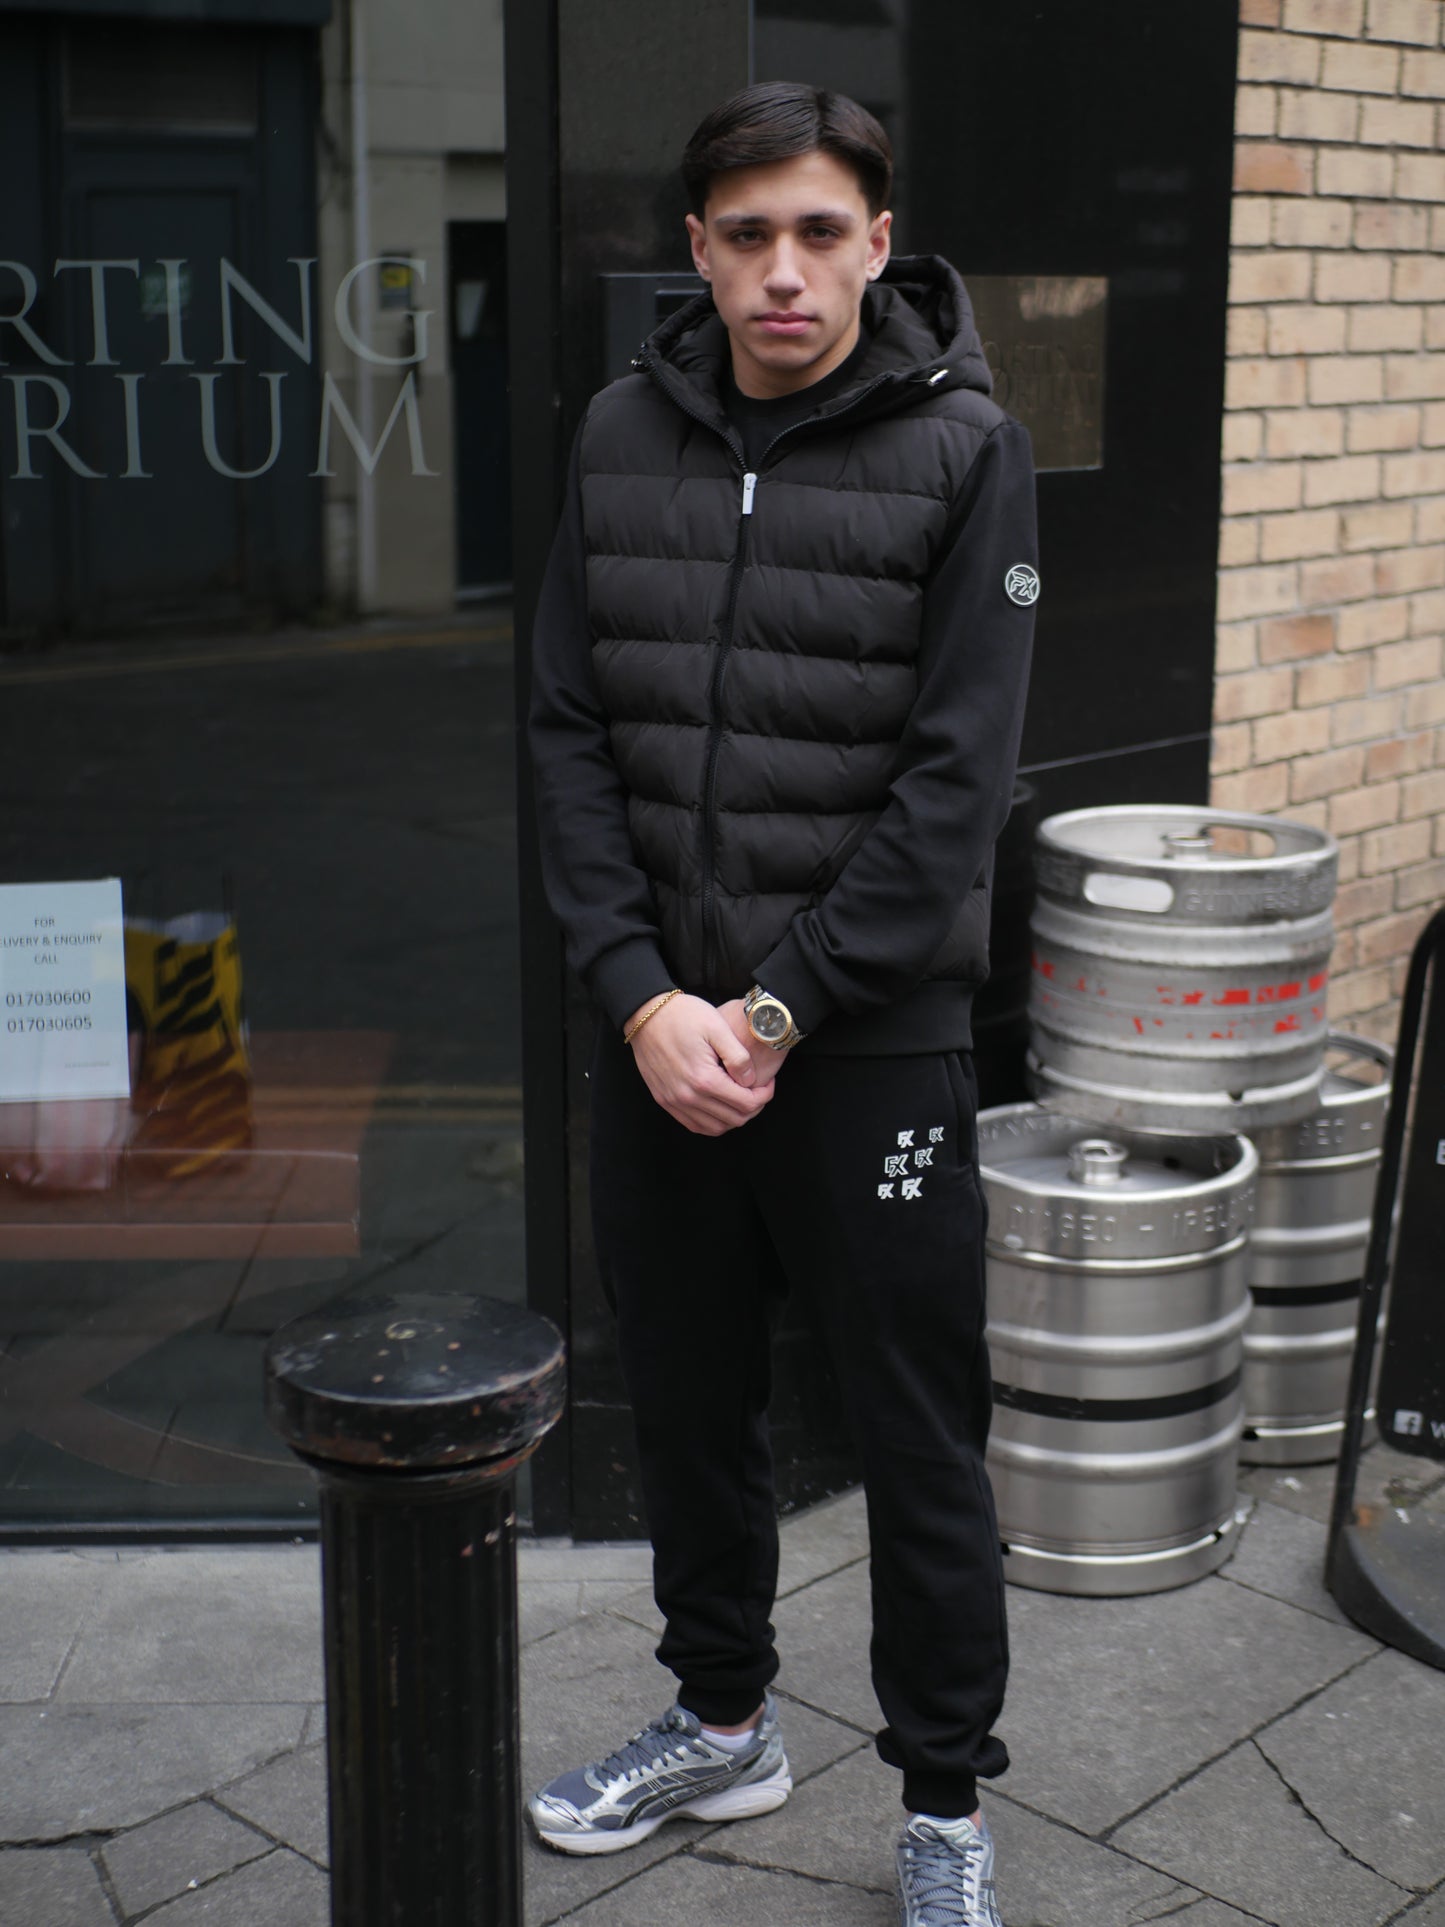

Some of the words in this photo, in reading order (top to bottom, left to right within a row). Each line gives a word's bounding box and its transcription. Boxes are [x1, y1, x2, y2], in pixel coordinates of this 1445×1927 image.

[0, 257, 434, 366] RTING
[2, 371, 440, 479] RIUM
[34, 916, 55, 928] FOR
[54, 933, 102, 945] ENQUIRY
[34, 954, 58, 965] CALL
